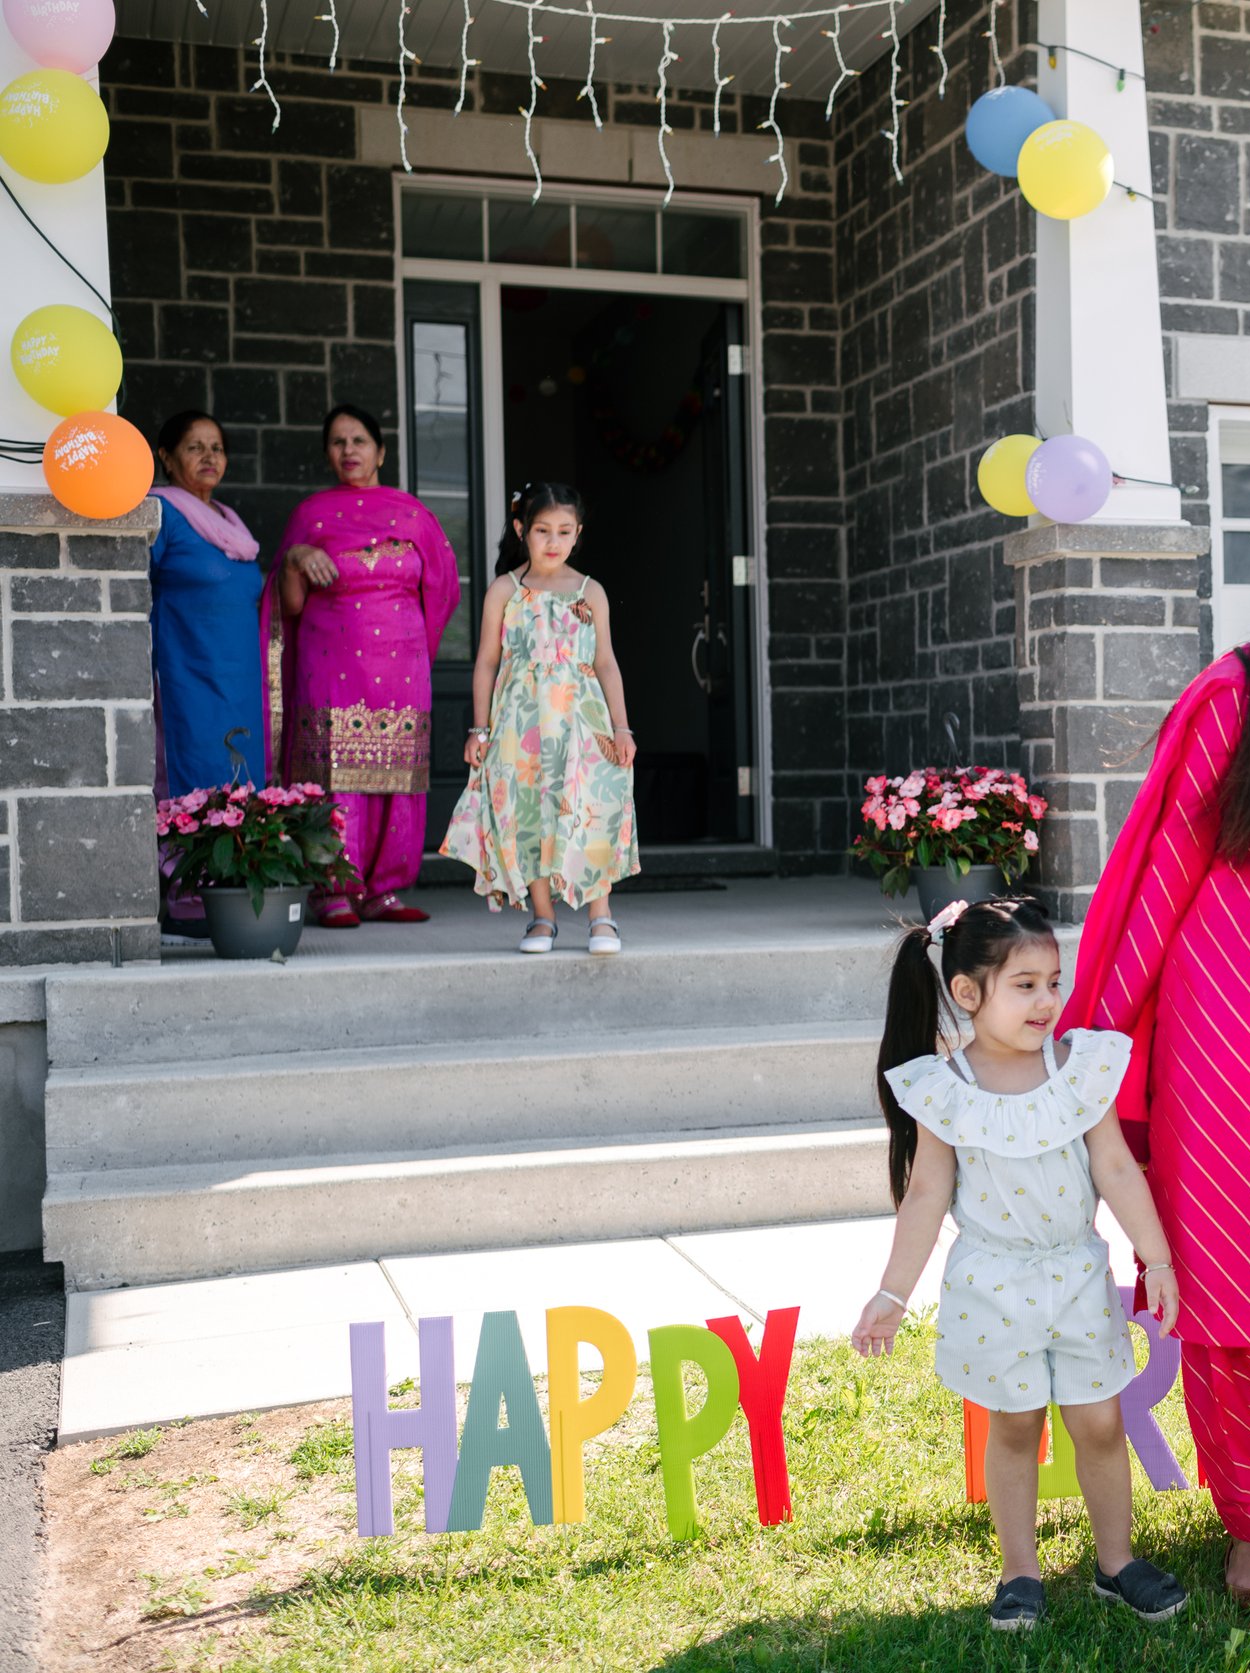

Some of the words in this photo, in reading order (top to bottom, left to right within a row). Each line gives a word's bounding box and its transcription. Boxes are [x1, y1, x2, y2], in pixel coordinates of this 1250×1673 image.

[54, 431, 97, 460] BIRTHDAY
[67, 443, 99, 466] HAPPY
[349, 1306, 800, 1541] HAPPY
